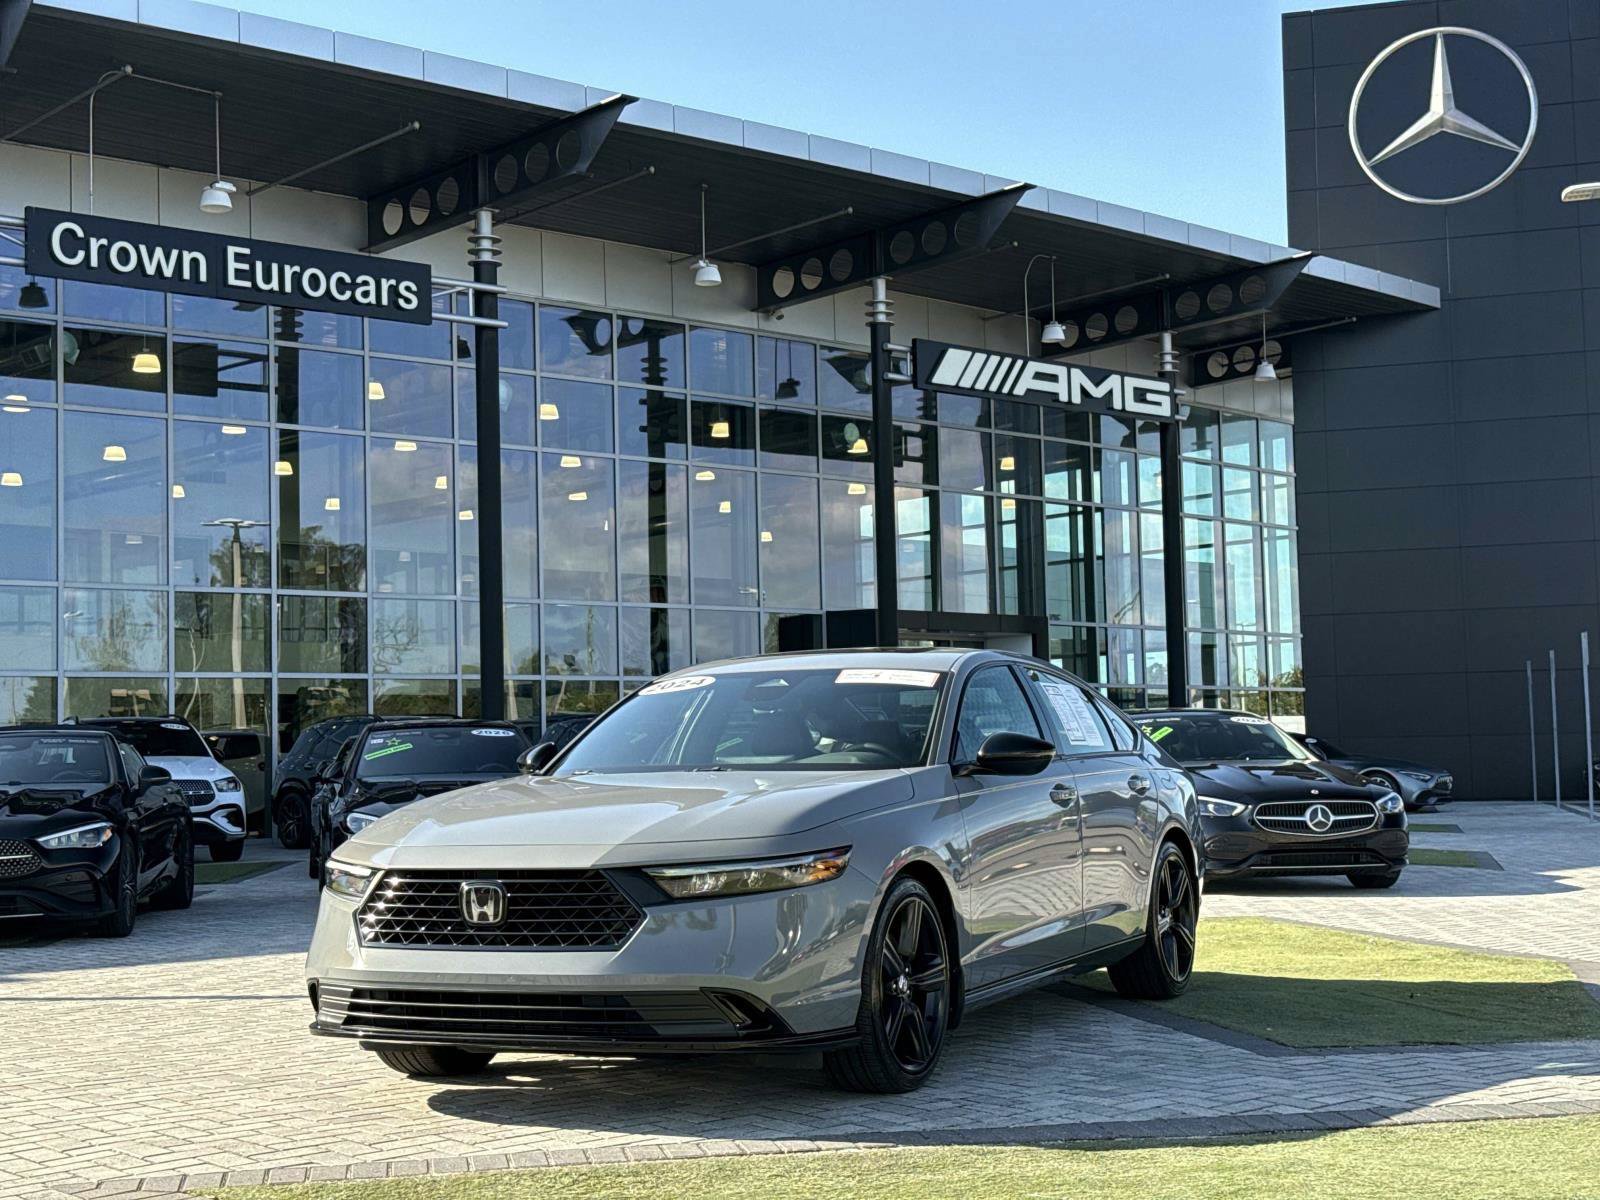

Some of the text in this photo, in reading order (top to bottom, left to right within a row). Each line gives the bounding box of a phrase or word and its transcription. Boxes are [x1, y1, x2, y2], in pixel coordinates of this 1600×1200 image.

[50, 221, 419, 311] Crown Eurocars
[1012, 360, 1172, 417] AMG
[644, 677, 708, 693] 2024
